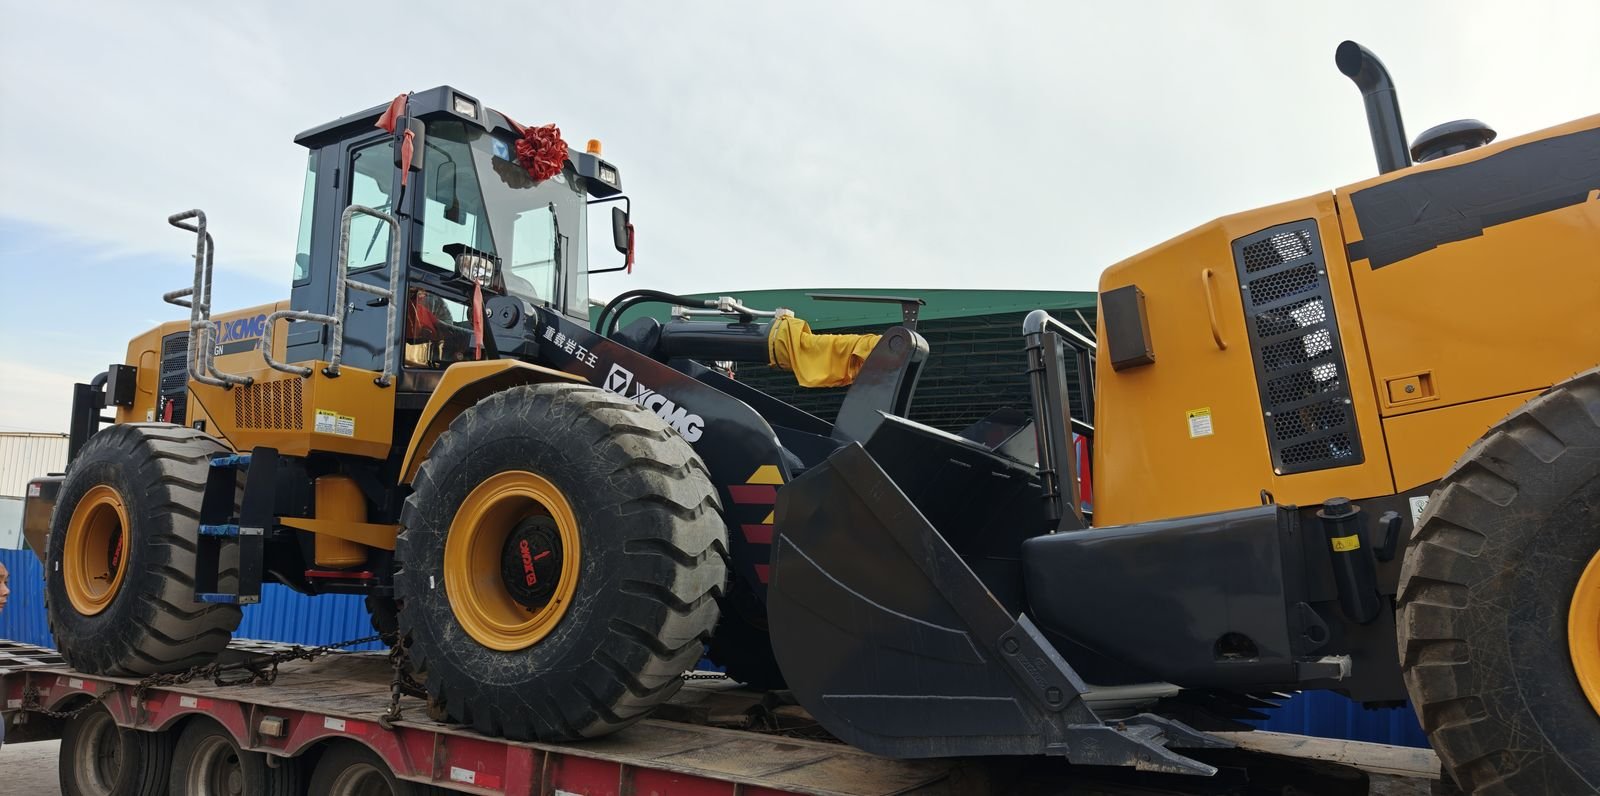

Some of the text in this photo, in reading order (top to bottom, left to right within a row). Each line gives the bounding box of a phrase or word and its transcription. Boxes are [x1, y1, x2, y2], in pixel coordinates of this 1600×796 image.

[223, 314, 266, 342] XCMG
[543, 326, 598, 368] 重载岩石王
[631, 382, 704, 442] XCMG
[520, 539, 534, 572] XCMG
